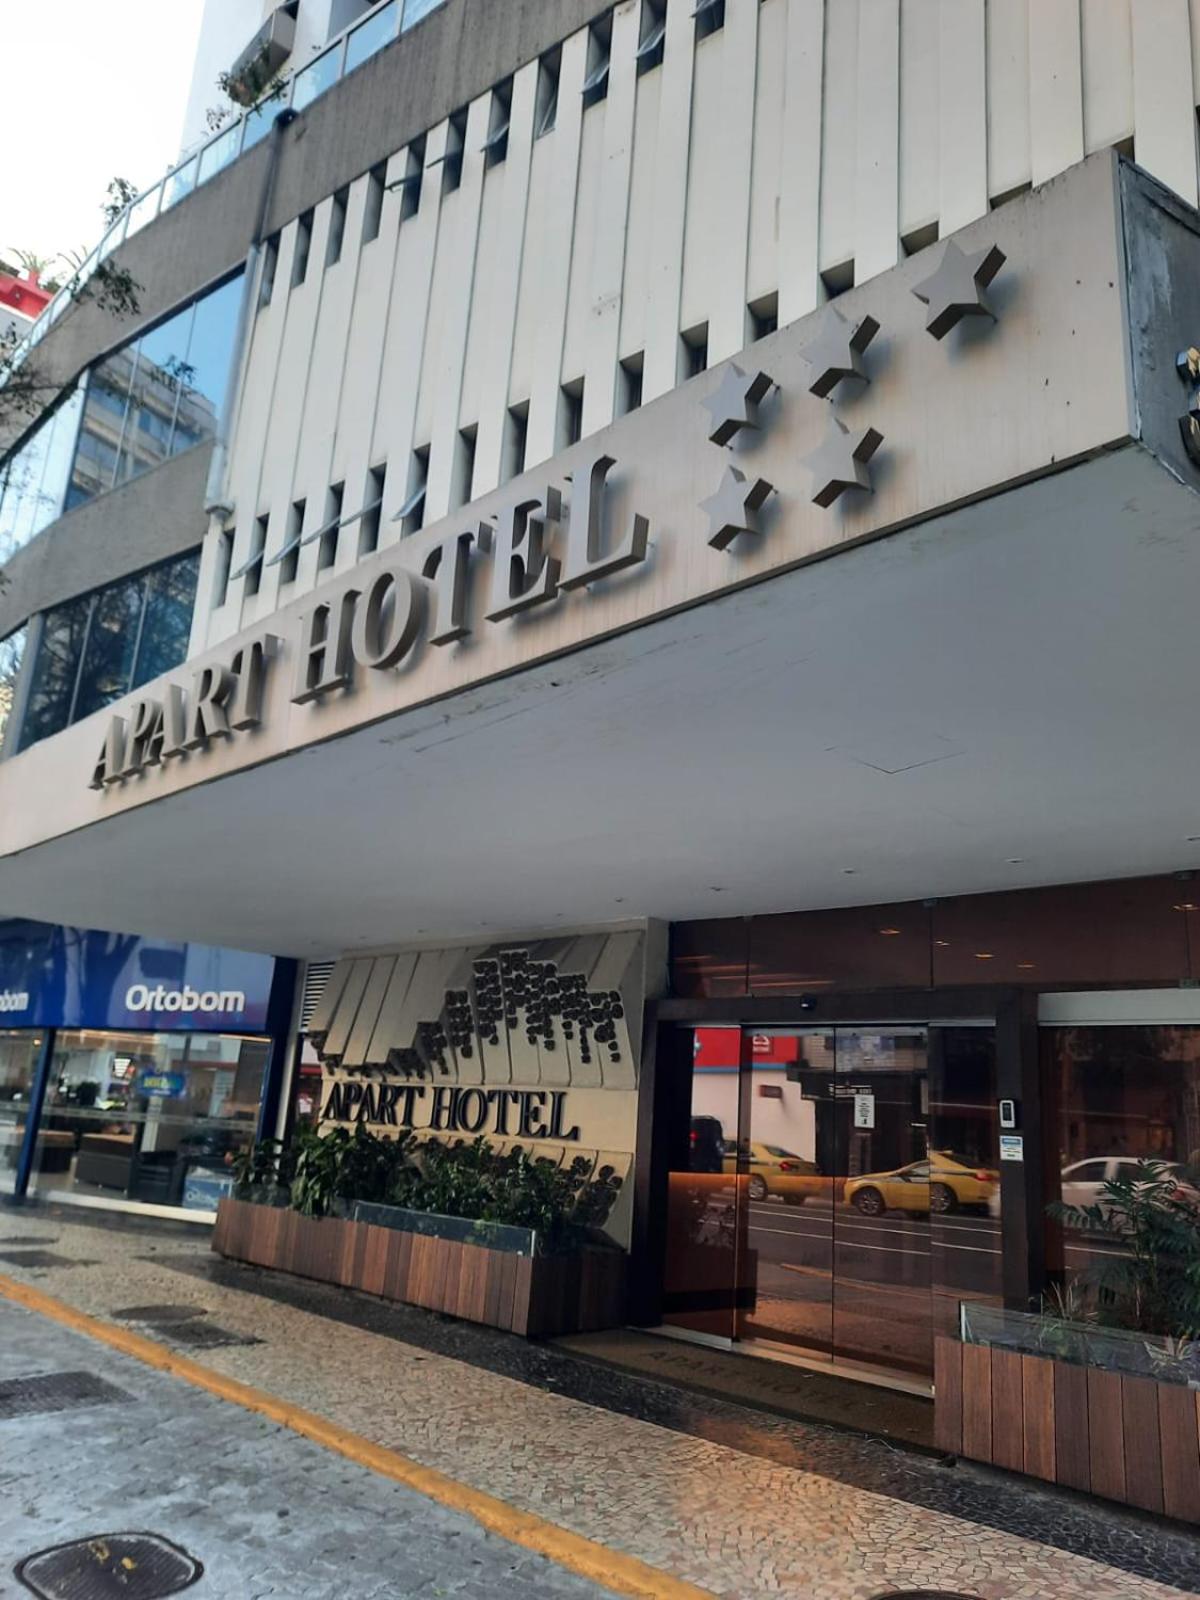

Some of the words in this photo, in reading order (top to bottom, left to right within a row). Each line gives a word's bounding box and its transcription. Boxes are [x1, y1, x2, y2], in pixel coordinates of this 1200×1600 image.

[89, 632, 280, 790] APART
[291, 455, 649, 705] HOTEL
[125, 985, 245, 1012] Ortobom
[322, 1082, 424, 1127] APART
[429, 1086, 579, 1141] HOTEL
